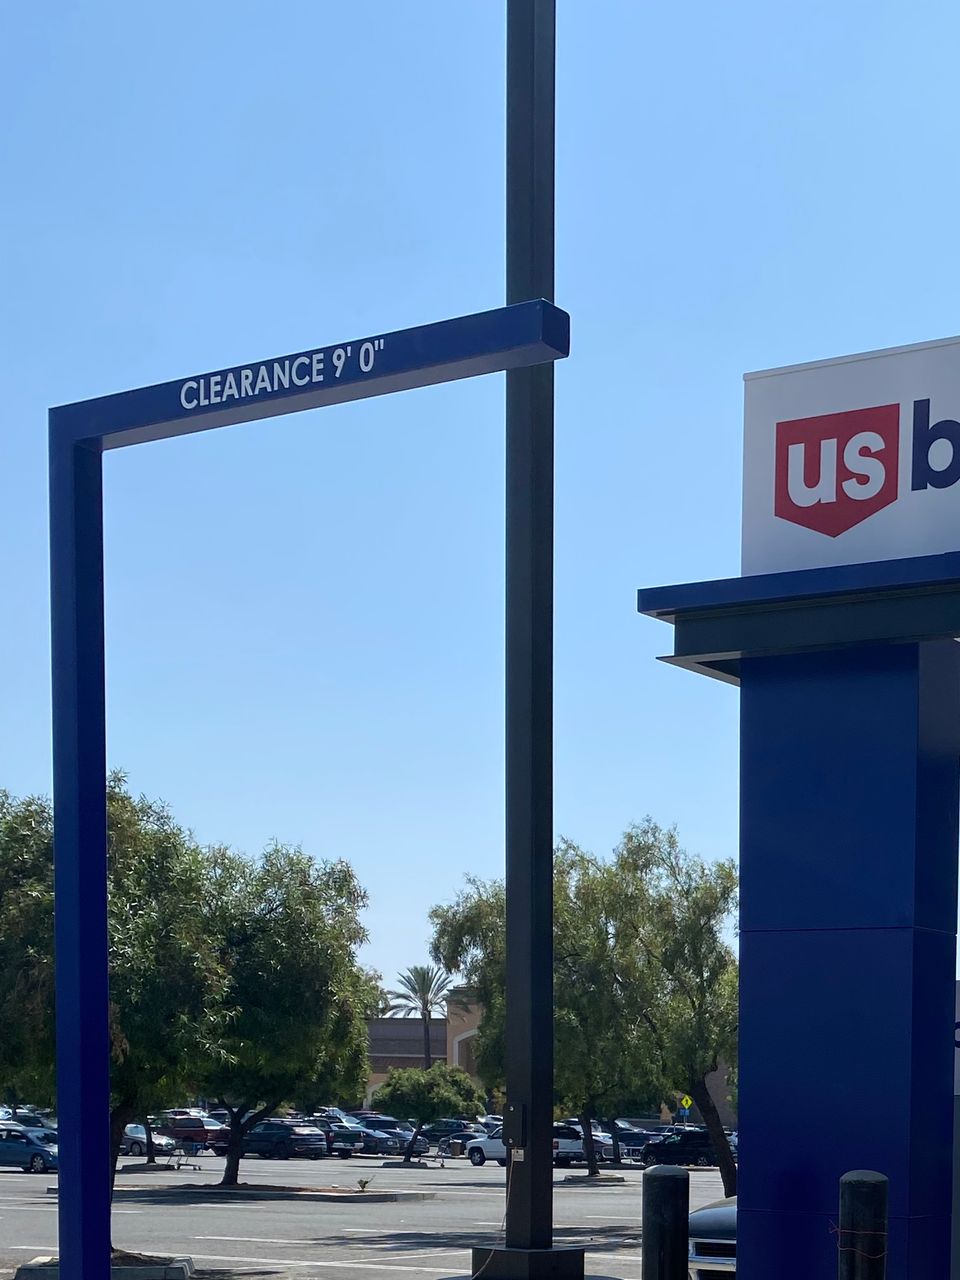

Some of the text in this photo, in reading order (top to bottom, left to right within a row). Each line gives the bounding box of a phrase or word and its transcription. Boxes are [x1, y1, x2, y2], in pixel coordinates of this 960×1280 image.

[180, 352, 324, 410] CLEARANCE
[332, 346, 352, 378] 9'
[787, 431, 886, 507] us
